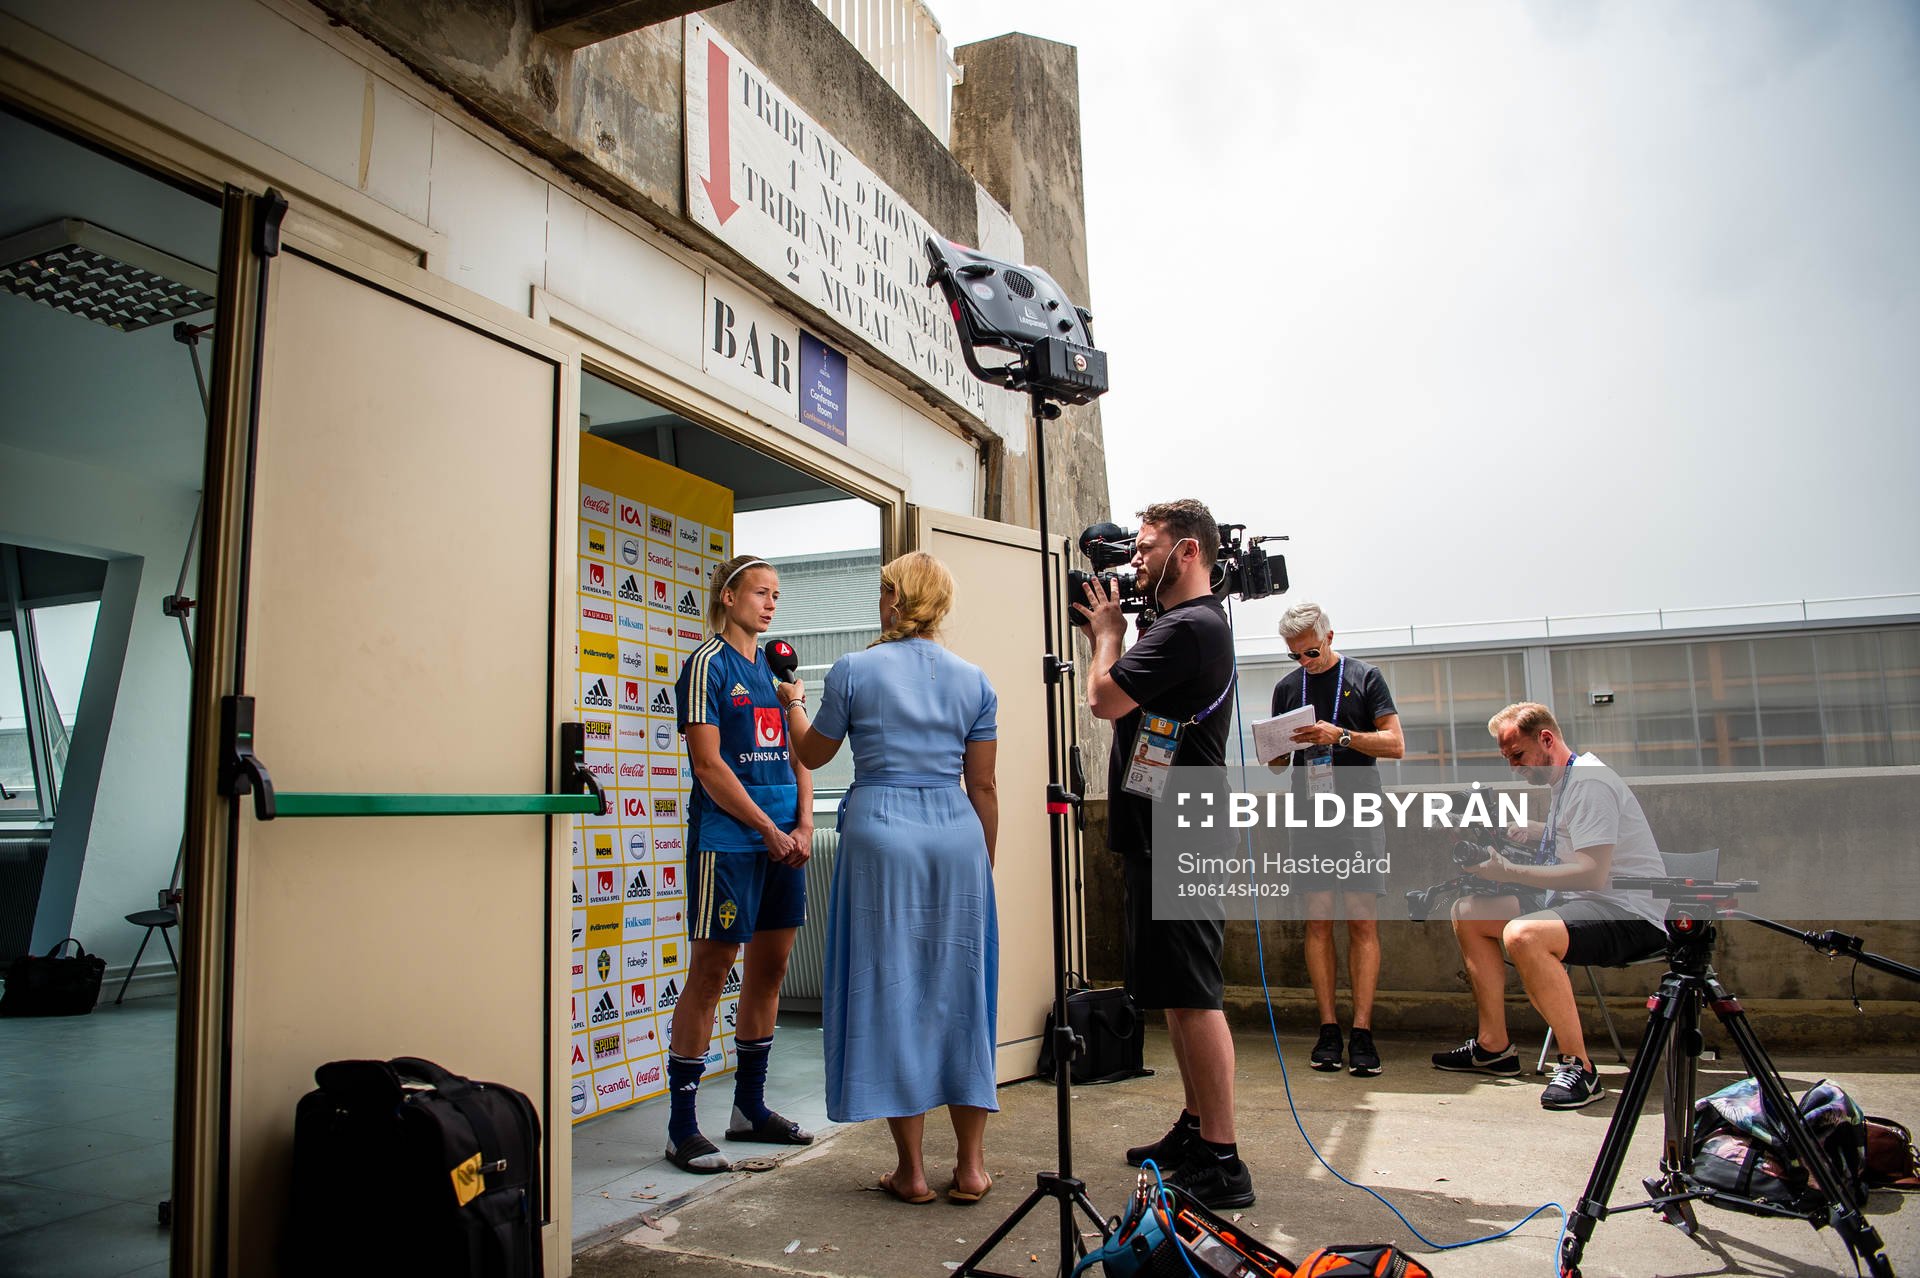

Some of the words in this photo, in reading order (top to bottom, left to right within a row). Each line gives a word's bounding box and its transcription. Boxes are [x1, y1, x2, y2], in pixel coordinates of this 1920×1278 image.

[738, 67, 842, 187] TRIBUNE
[741, 162, 843, 272] TRIBUNE
[820, 182, 894, 269] NIVEAU
[820, 268, 895, 349] NIVEAU
[712, 296, 792, 394] BAR
[817, 380, 833, 397] Press
[810, 388, 839, 412] Conference
[816, 403, 833, 420] Room
[620, 504, 642, 527] ICA
[679, 528, 698, 544] Fabege
[647, 552, 673, 568] Scandic
[582, 585, 602, 594] SVENSKA
[602, 589, 612, 597] SPEL
[618, 589, 643, 603] adidas
[583, 609, 613, 622] BAUHAUS
[677, 604, 701, 617] adidas
[618, 615, 644, 630] Folksam
[780, 643, 790, 655] 4
[623, 653, 642, 668] Fabege
[584, 695, 613, 707] adidas
[650, 703, 675, 714] adidas
[732, 695, 753, 708] ICA
[585, 720, 611, 735] SPORT
[739, 751, 781, 764] SVENSKA
[624, 798, 647, 817] ICA
[655, 799, 676, 812] SPORT
[654, 839, 682, 850] Scandic
[590, 896, 610, 904] SVENSKA
[626, 887, 651, 899] adidas
[624, 917, 652, 929] Folksam
[627, 956, 648, 968] Fabege
[722, 984, 741, 995] adida
[591, 1009, 619, 1024] adidas
[593, 1035, 620, 1054] SPORT
[596, 1078, 631, 1096] Scandic
